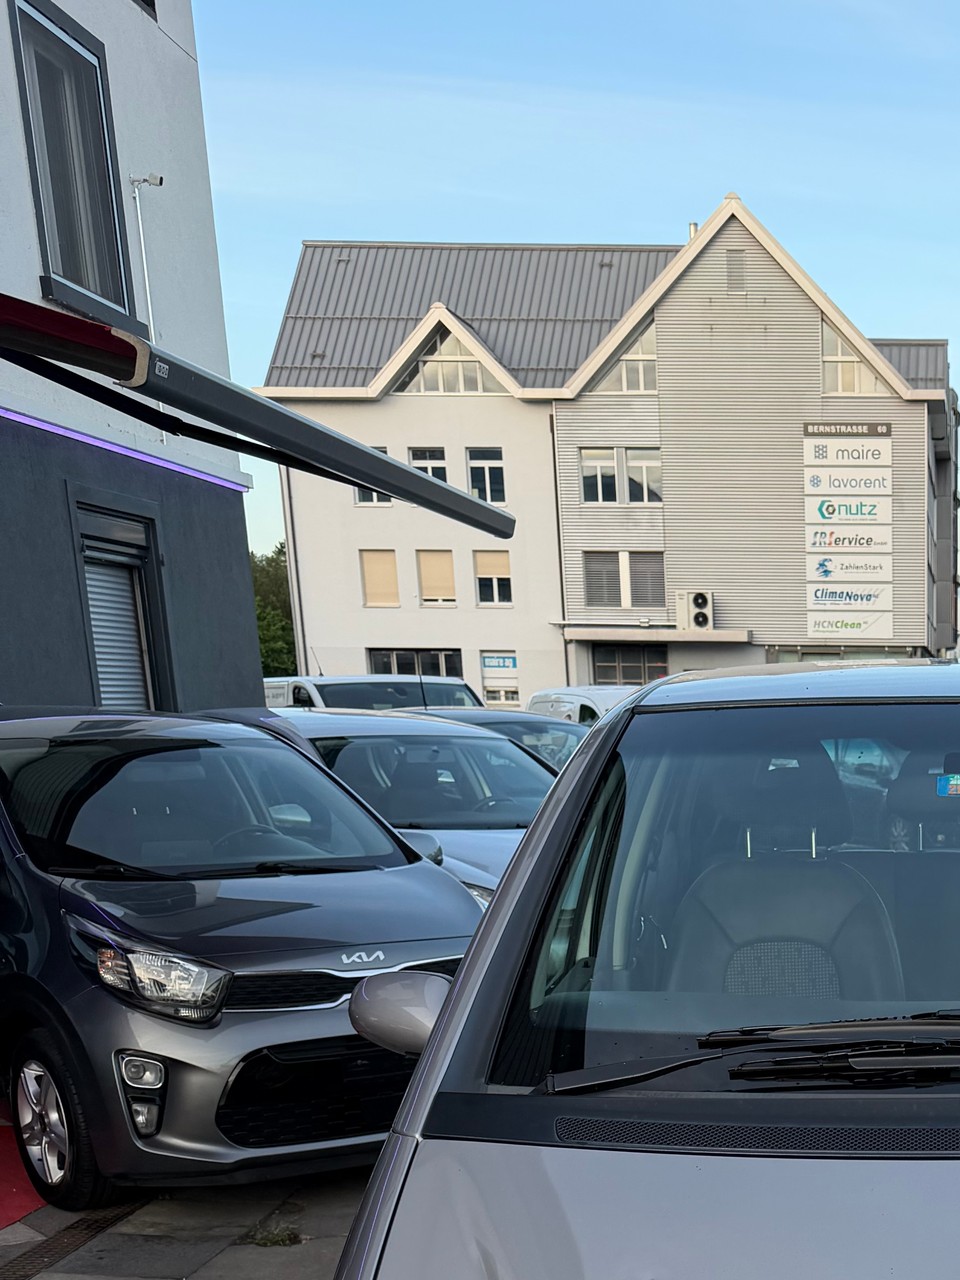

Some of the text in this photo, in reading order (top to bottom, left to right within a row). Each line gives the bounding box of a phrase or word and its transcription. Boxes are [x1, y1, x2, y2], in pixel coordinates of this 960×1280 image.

[807, 425, 887, 433] BERNSTRASSE 60
[836, 444, 881, 460] maire
[828, 474, 887, 489] lavorent
[840, 563, 883, 571] ZahlenStark
[814, 588, 872, 602] ClimaNova
[813, 620, 862, 629] HCNClean
